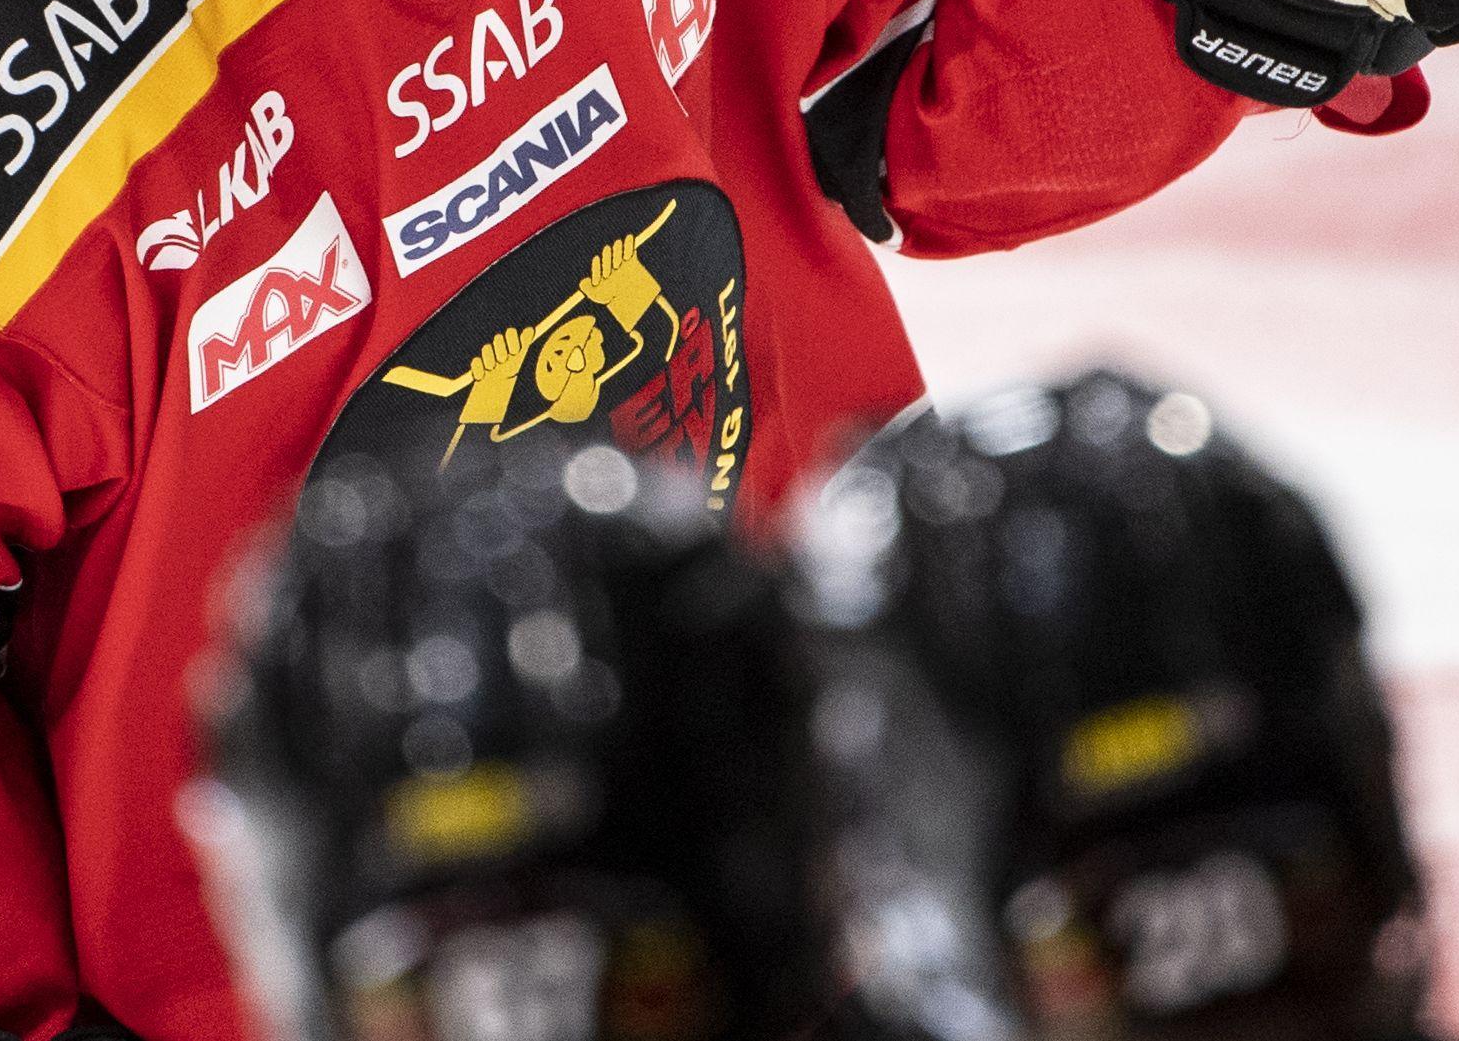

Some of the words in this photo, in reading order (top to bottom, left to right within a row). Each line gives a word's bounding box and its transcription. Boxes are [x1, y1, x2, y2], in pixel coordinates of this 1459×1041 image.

[1192, 26, 1328, 94] BAUER
[197, 90, 295, 252] LKAB
[399, 88, 621, 260] SCANIA
[199, 234, 362, 402] MAX
